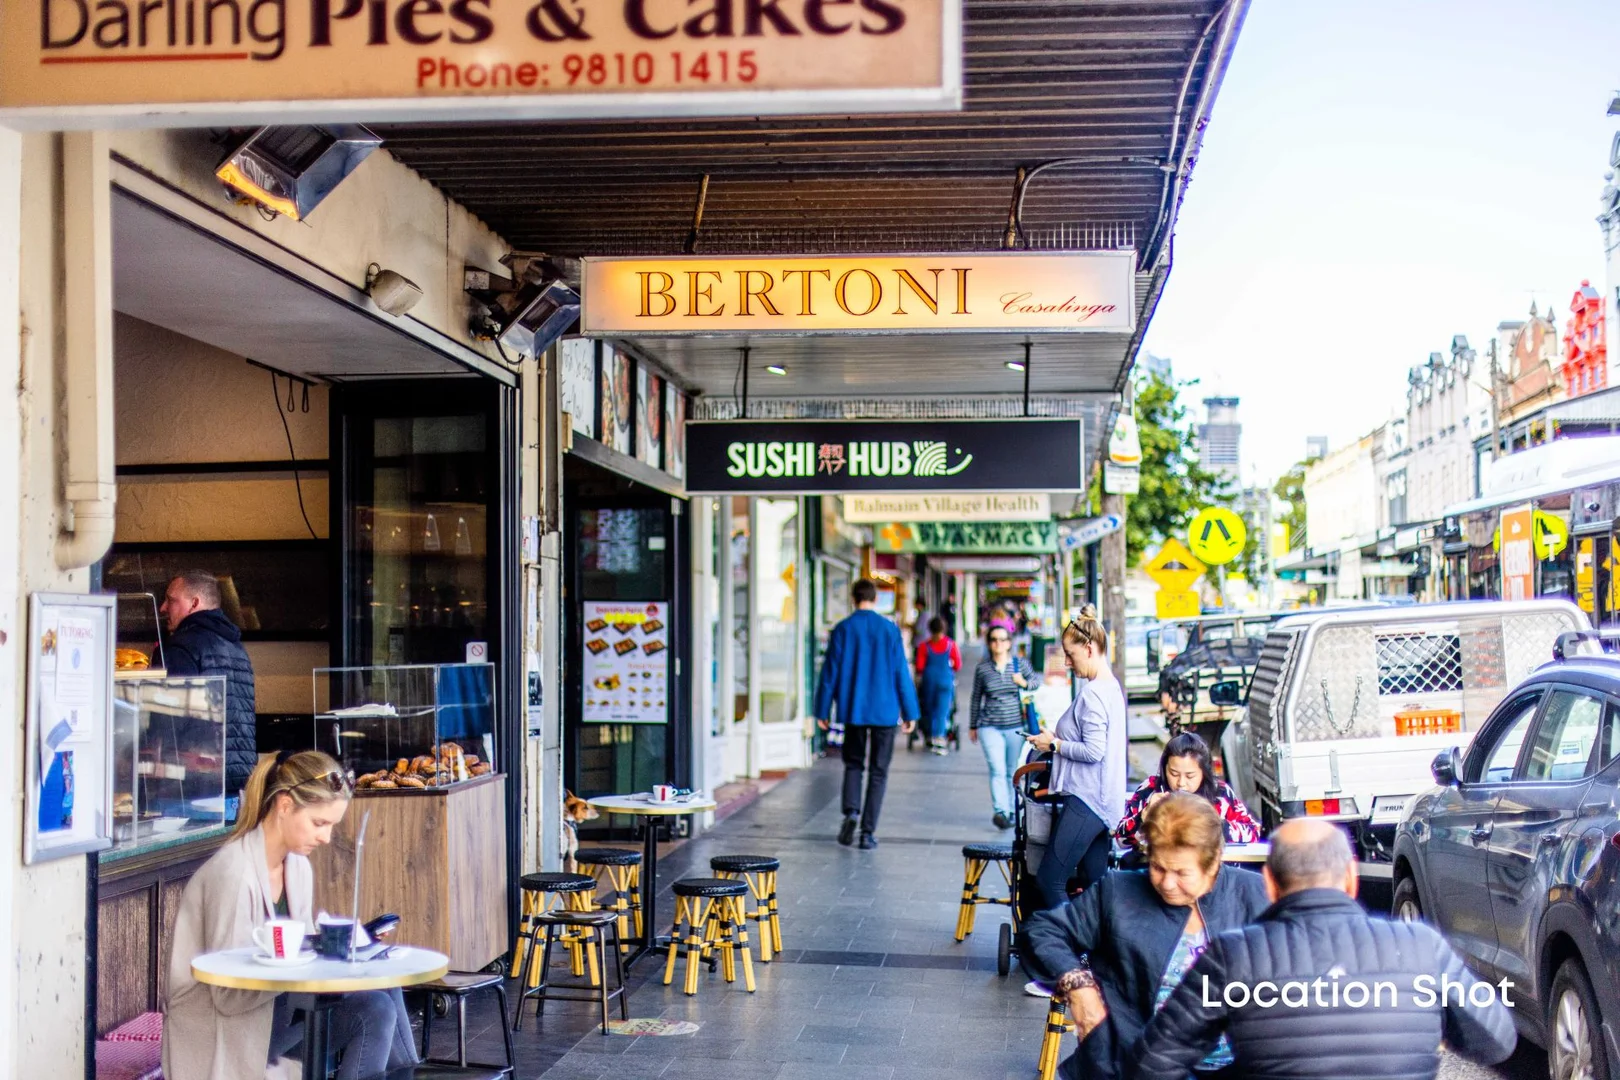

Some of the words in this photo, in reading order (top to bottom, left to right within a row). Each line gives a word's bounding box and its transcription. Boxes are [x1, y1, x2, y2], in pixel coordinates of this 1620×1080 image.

[40, 0, 286, 61] Darling
[308, 0, 495, 48] Pies
[525, 0, 593, 44] &
[622, 0, 907, 40] Cakes
[416, 56, 549, 89] Phone:
[562, 51, 655, 86] 9810
[671, 49, 758, 84] 1415
[635, 268, 973, 317] BERTONI
[998, 291, 1118, 322] Casalinga
[727, 441, 816, 478] SUSHI
[849, 441, 913, 477] HUB
[924, 496, 981, 515] Village
[986, 495, 1040, 511] Health
[920, 528, 1051, 547] PHARMACY
